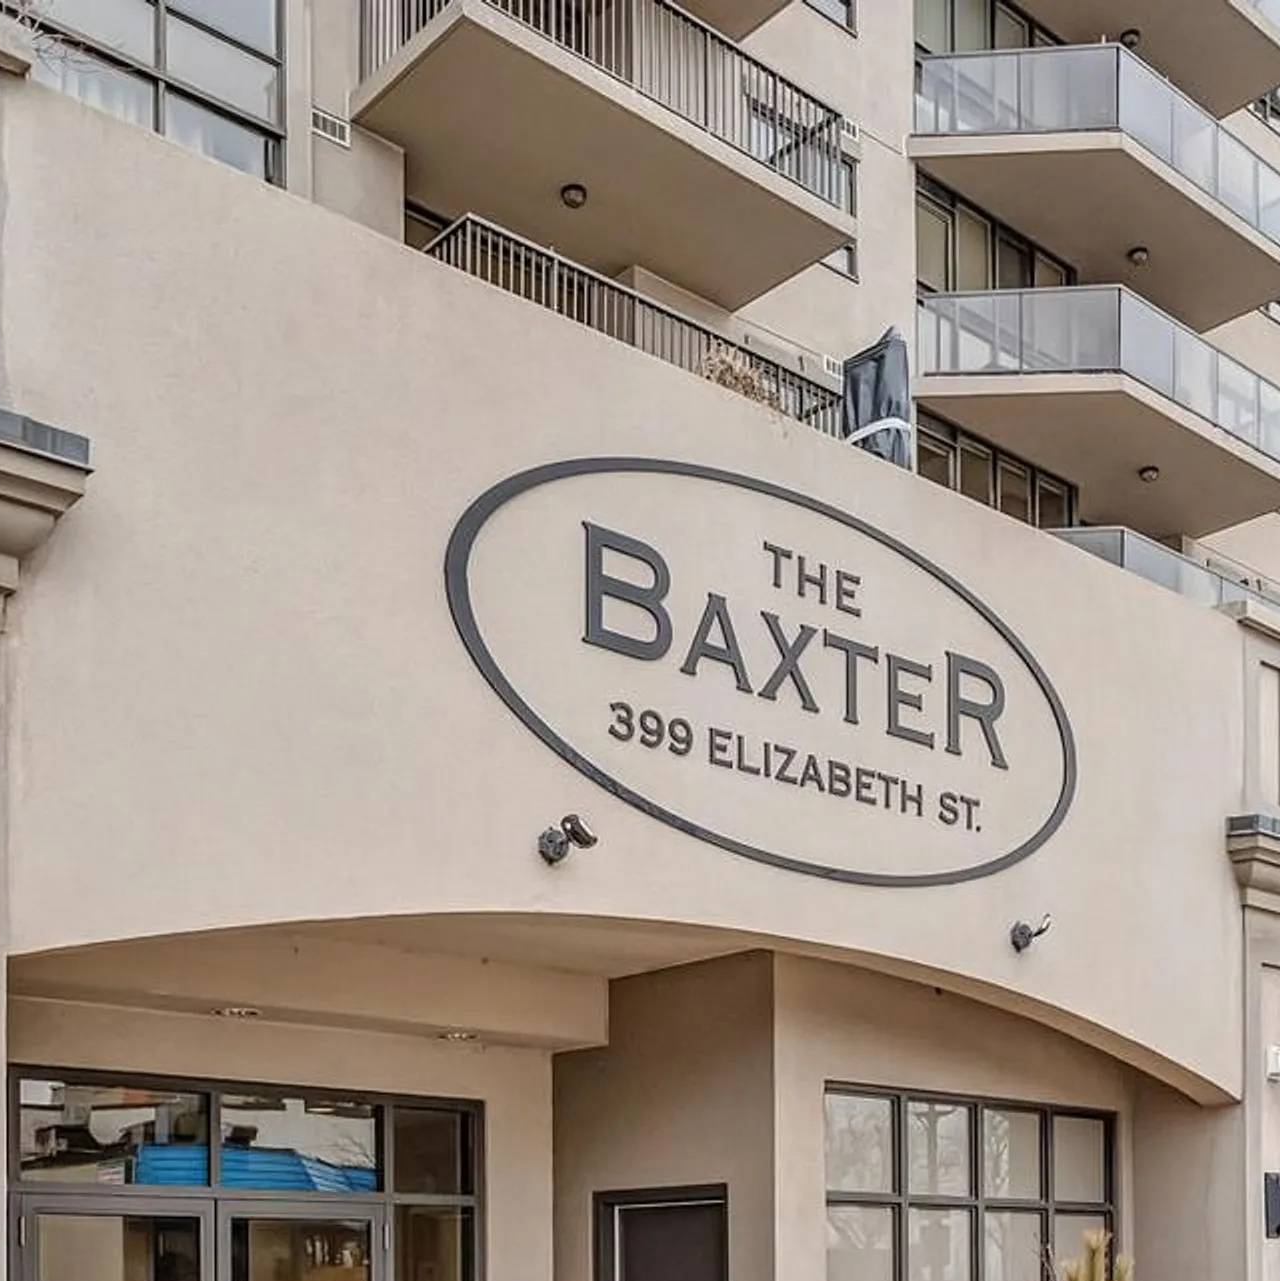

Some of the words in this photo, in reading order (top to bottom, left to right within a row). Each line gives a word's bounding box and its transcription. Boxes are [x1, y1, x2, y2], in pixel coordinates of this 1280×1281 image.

[763, 540, 862, 618] THE
[581, 520, 1010, 771] BAXTER
[608, 701, 694, 757] 399
[708, 726, 924, 818] ELIZABETH
[938, 791, 983, 833] ST.
